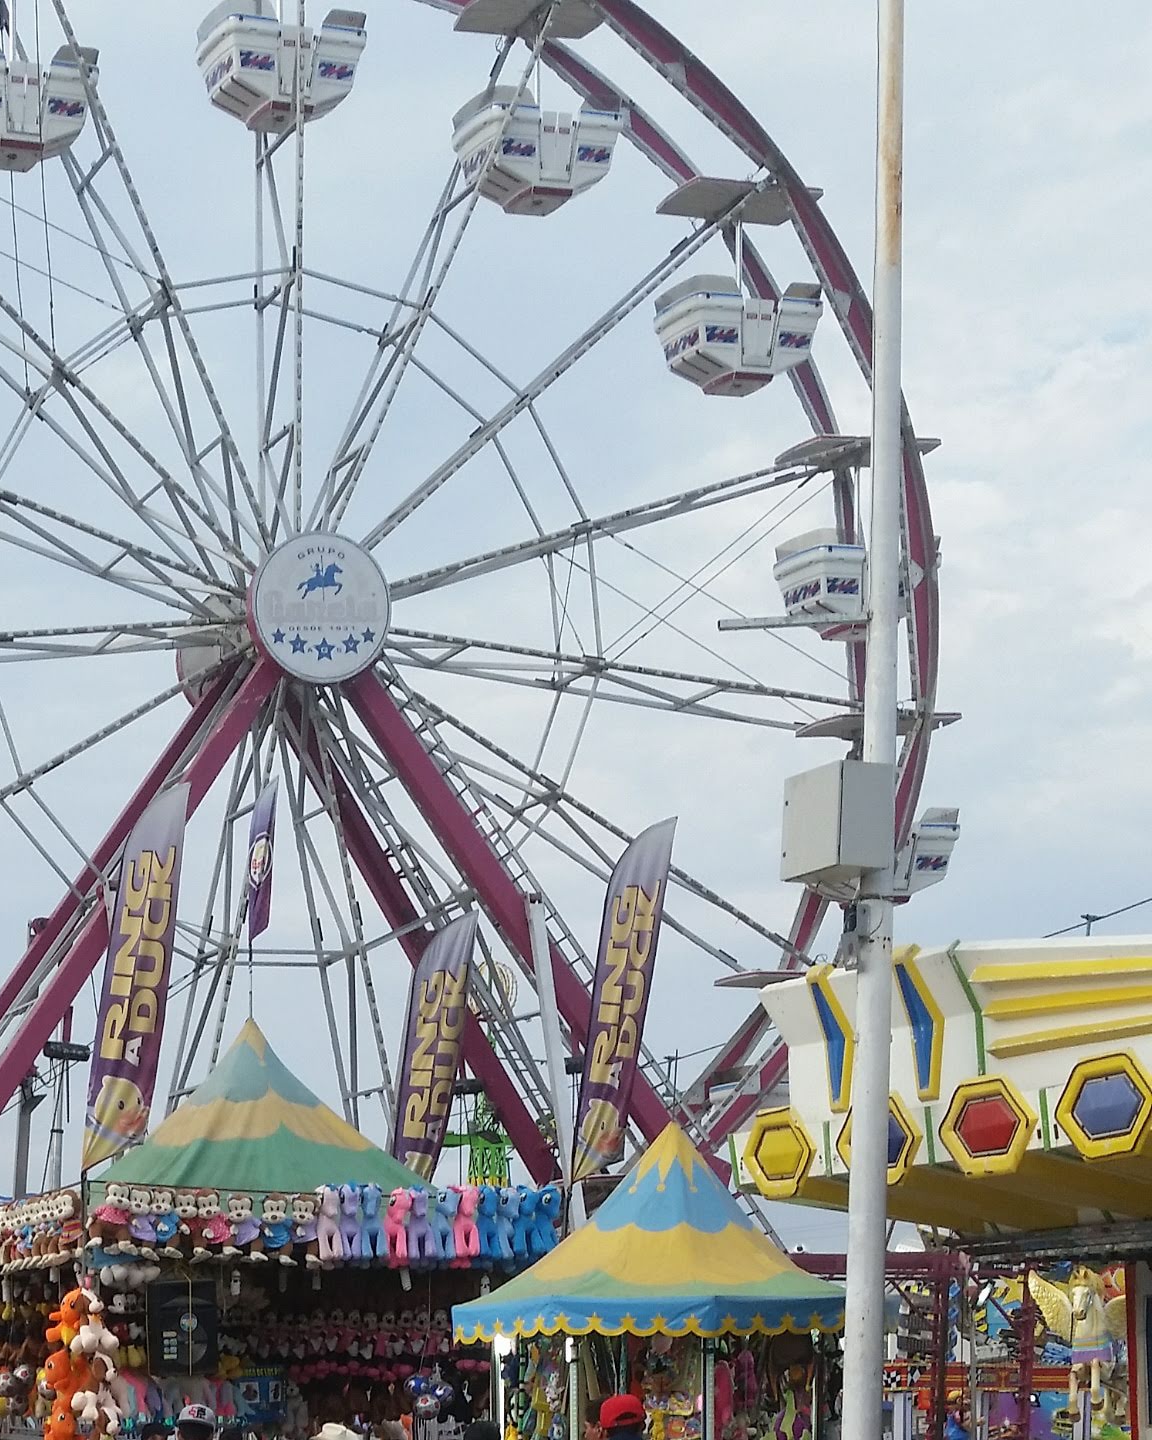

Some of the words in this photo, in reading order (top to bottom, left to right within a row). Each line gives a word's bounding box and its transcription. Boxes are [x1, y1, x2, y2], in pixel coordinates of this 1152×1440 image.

[297, 546, 345, 560] GRUPO
[100, 850, 152, 1060] RING
[129, 846, 176, 1033] DUCK
[589, 885, 639, 1084] RING
[616, 880, 661, 1059] DUCK
[124, 1035, 143, 1067] A
[403, 969, 446, 1139] RING
[430, 962, 469, 1116] DUCK
